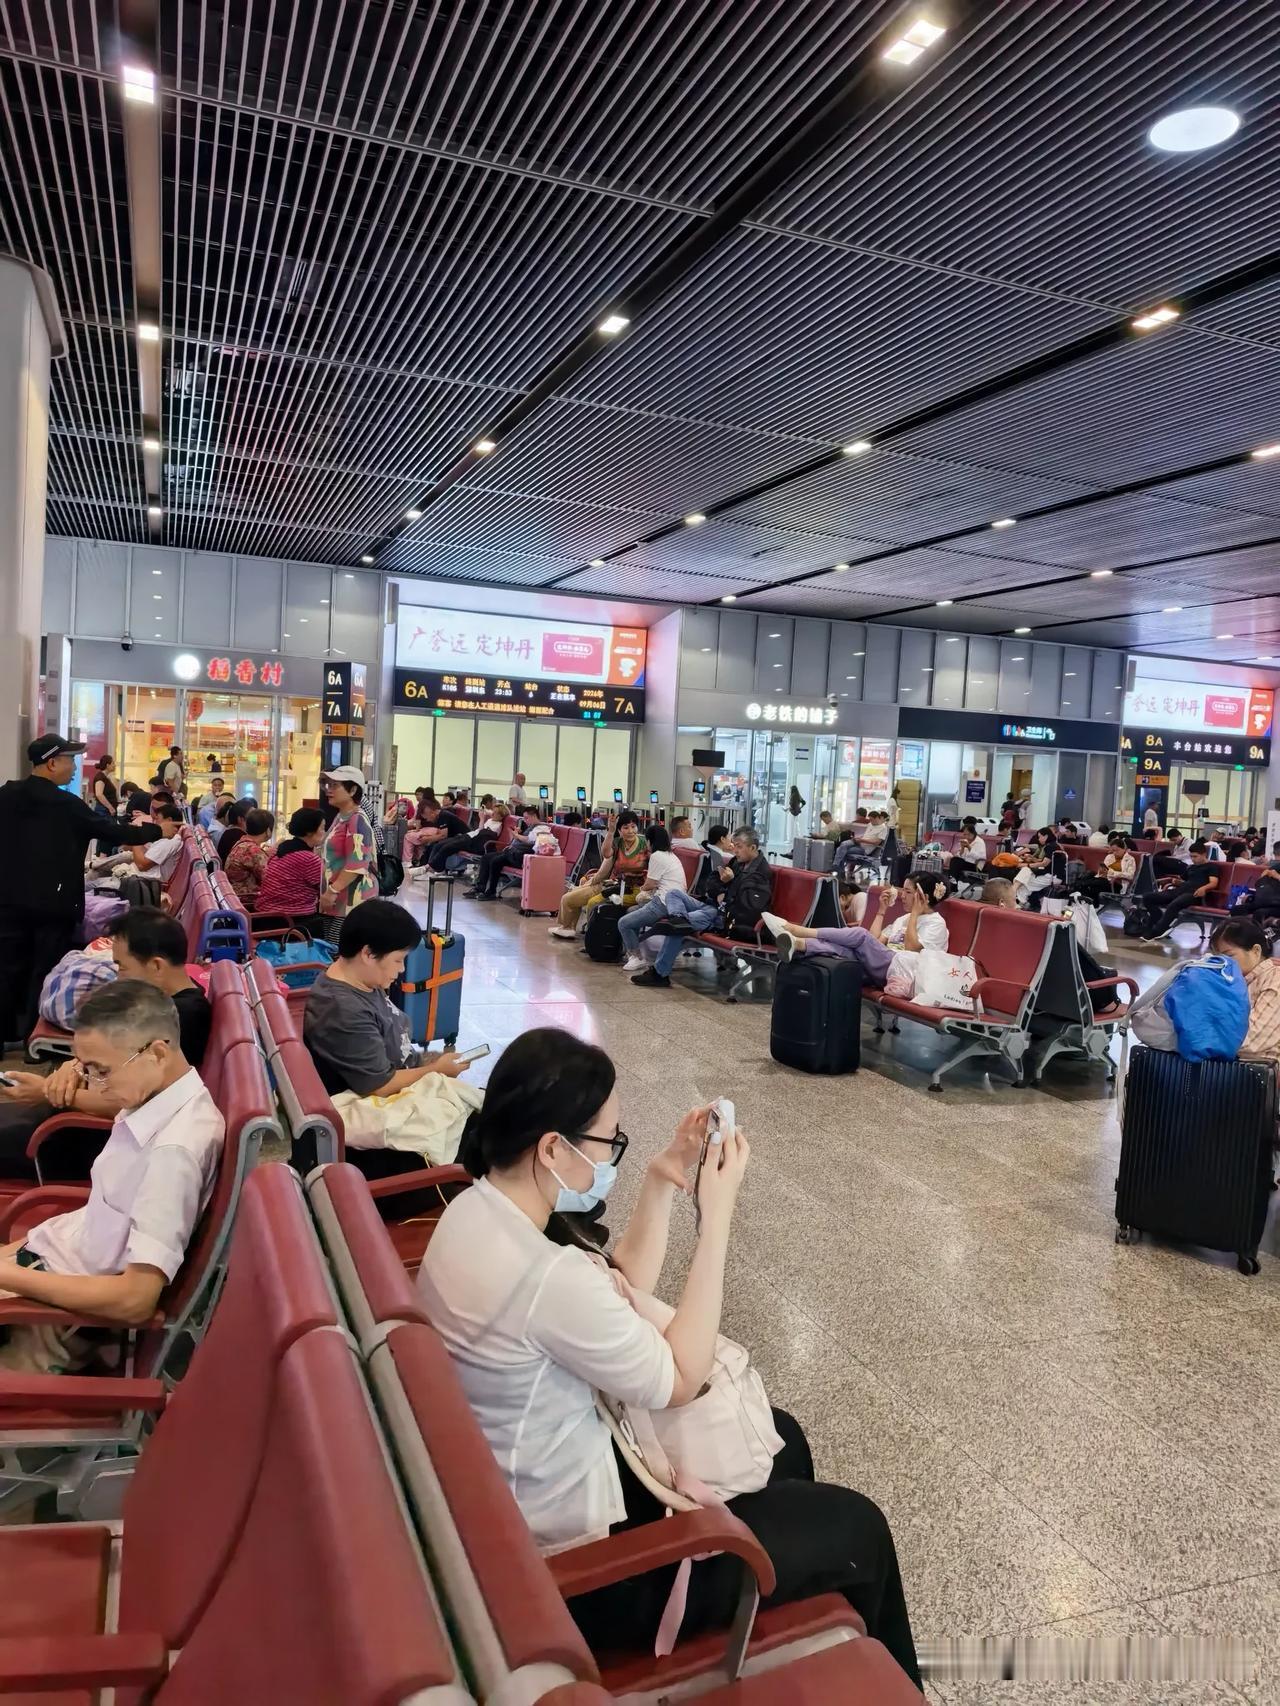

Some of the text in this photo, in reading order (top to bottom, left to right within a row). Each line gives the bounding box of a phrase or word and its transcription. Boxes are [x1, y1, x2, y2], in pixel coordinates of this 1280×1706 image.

[208, 657, 284, 686] 稻香村
[327, 671, 342, 685] 6A
[354, 671, 364, 687] 6A
[404, 680, 428, 699] 6A
[327, 701, 341, 716] 7A
[353, 702, 363, 718] 7A
[614, 697, 635, 715] 7A
[762, 704, 838, 725] 老铁的铺子
[1146, 735, 1163, 747] 8A
[1173, 741, 1232, 755] 丰台站欢迎您
[1250, 745, 1264, 759] 9A
[1144, 758, 1162, 770] 9A
